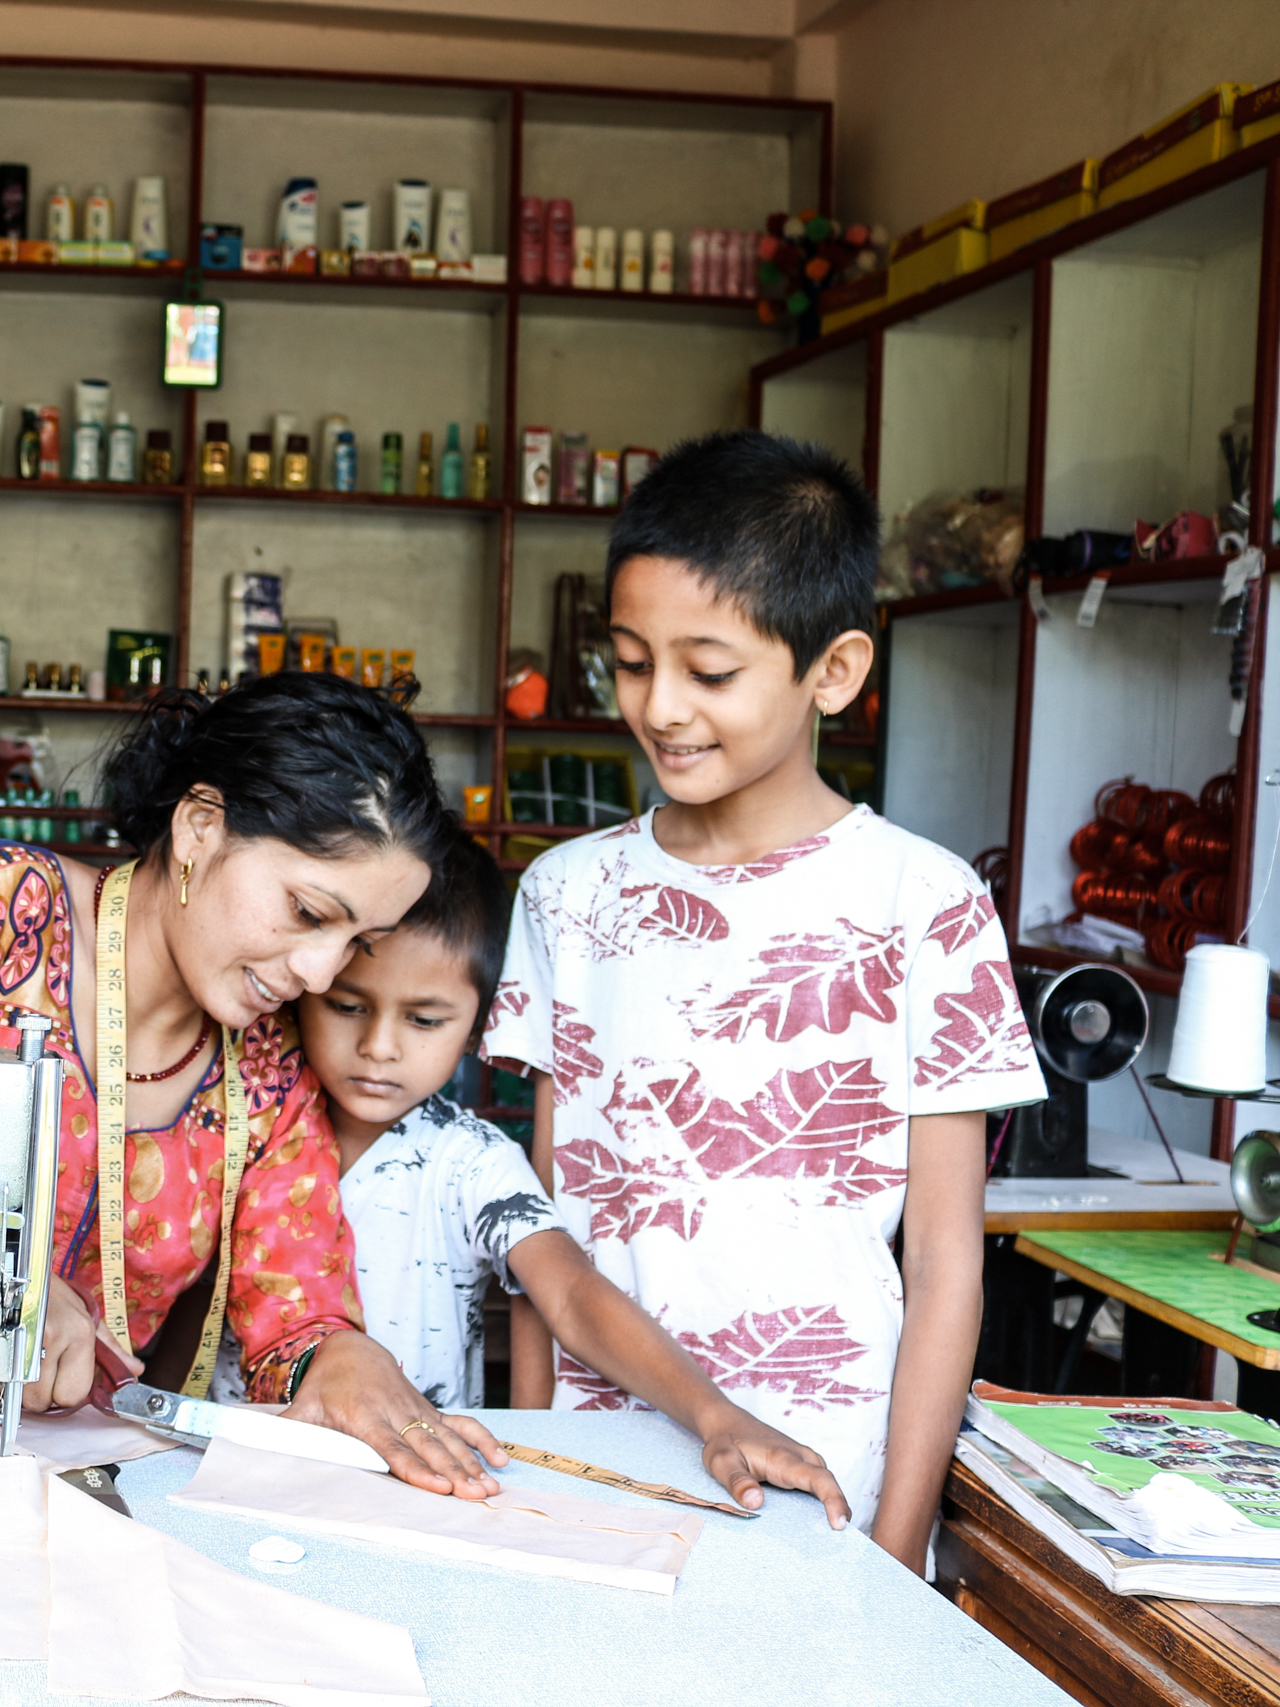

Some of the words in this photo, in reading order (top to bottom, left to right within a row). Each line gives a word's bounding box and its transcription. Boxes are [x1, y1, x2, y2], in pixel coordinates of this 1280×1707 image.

[114, 868, 131, 885] 31
[110, 895, 125, 917] 30
[108, 930, 123, 953] 29
[108, 968, 123, 991] 28
[109, 1007, 124, 1029] 27
[109, 1044, 124, 1068] 26
[109, 1083, 124, 1106] 25
[227, 1077, 238, 1098] 10
[228, 1113, 240, 1132] 11
[109, 1123, 123, 1145] 24
[227, 1150, 239, 1170] 12
[109, 1160, 123, 1183] 23
[110, 1200, 123, 1222] 22
[110, 1239, 123, 1261] 21
[112, 1277, 124, 1300] 20
[114, 1316, 127, 1338] 19
[201, 1329, 213, 1349] 17
[190, 1364, 205, 1381] 18
[542, 1453, 556, 1463] 5
